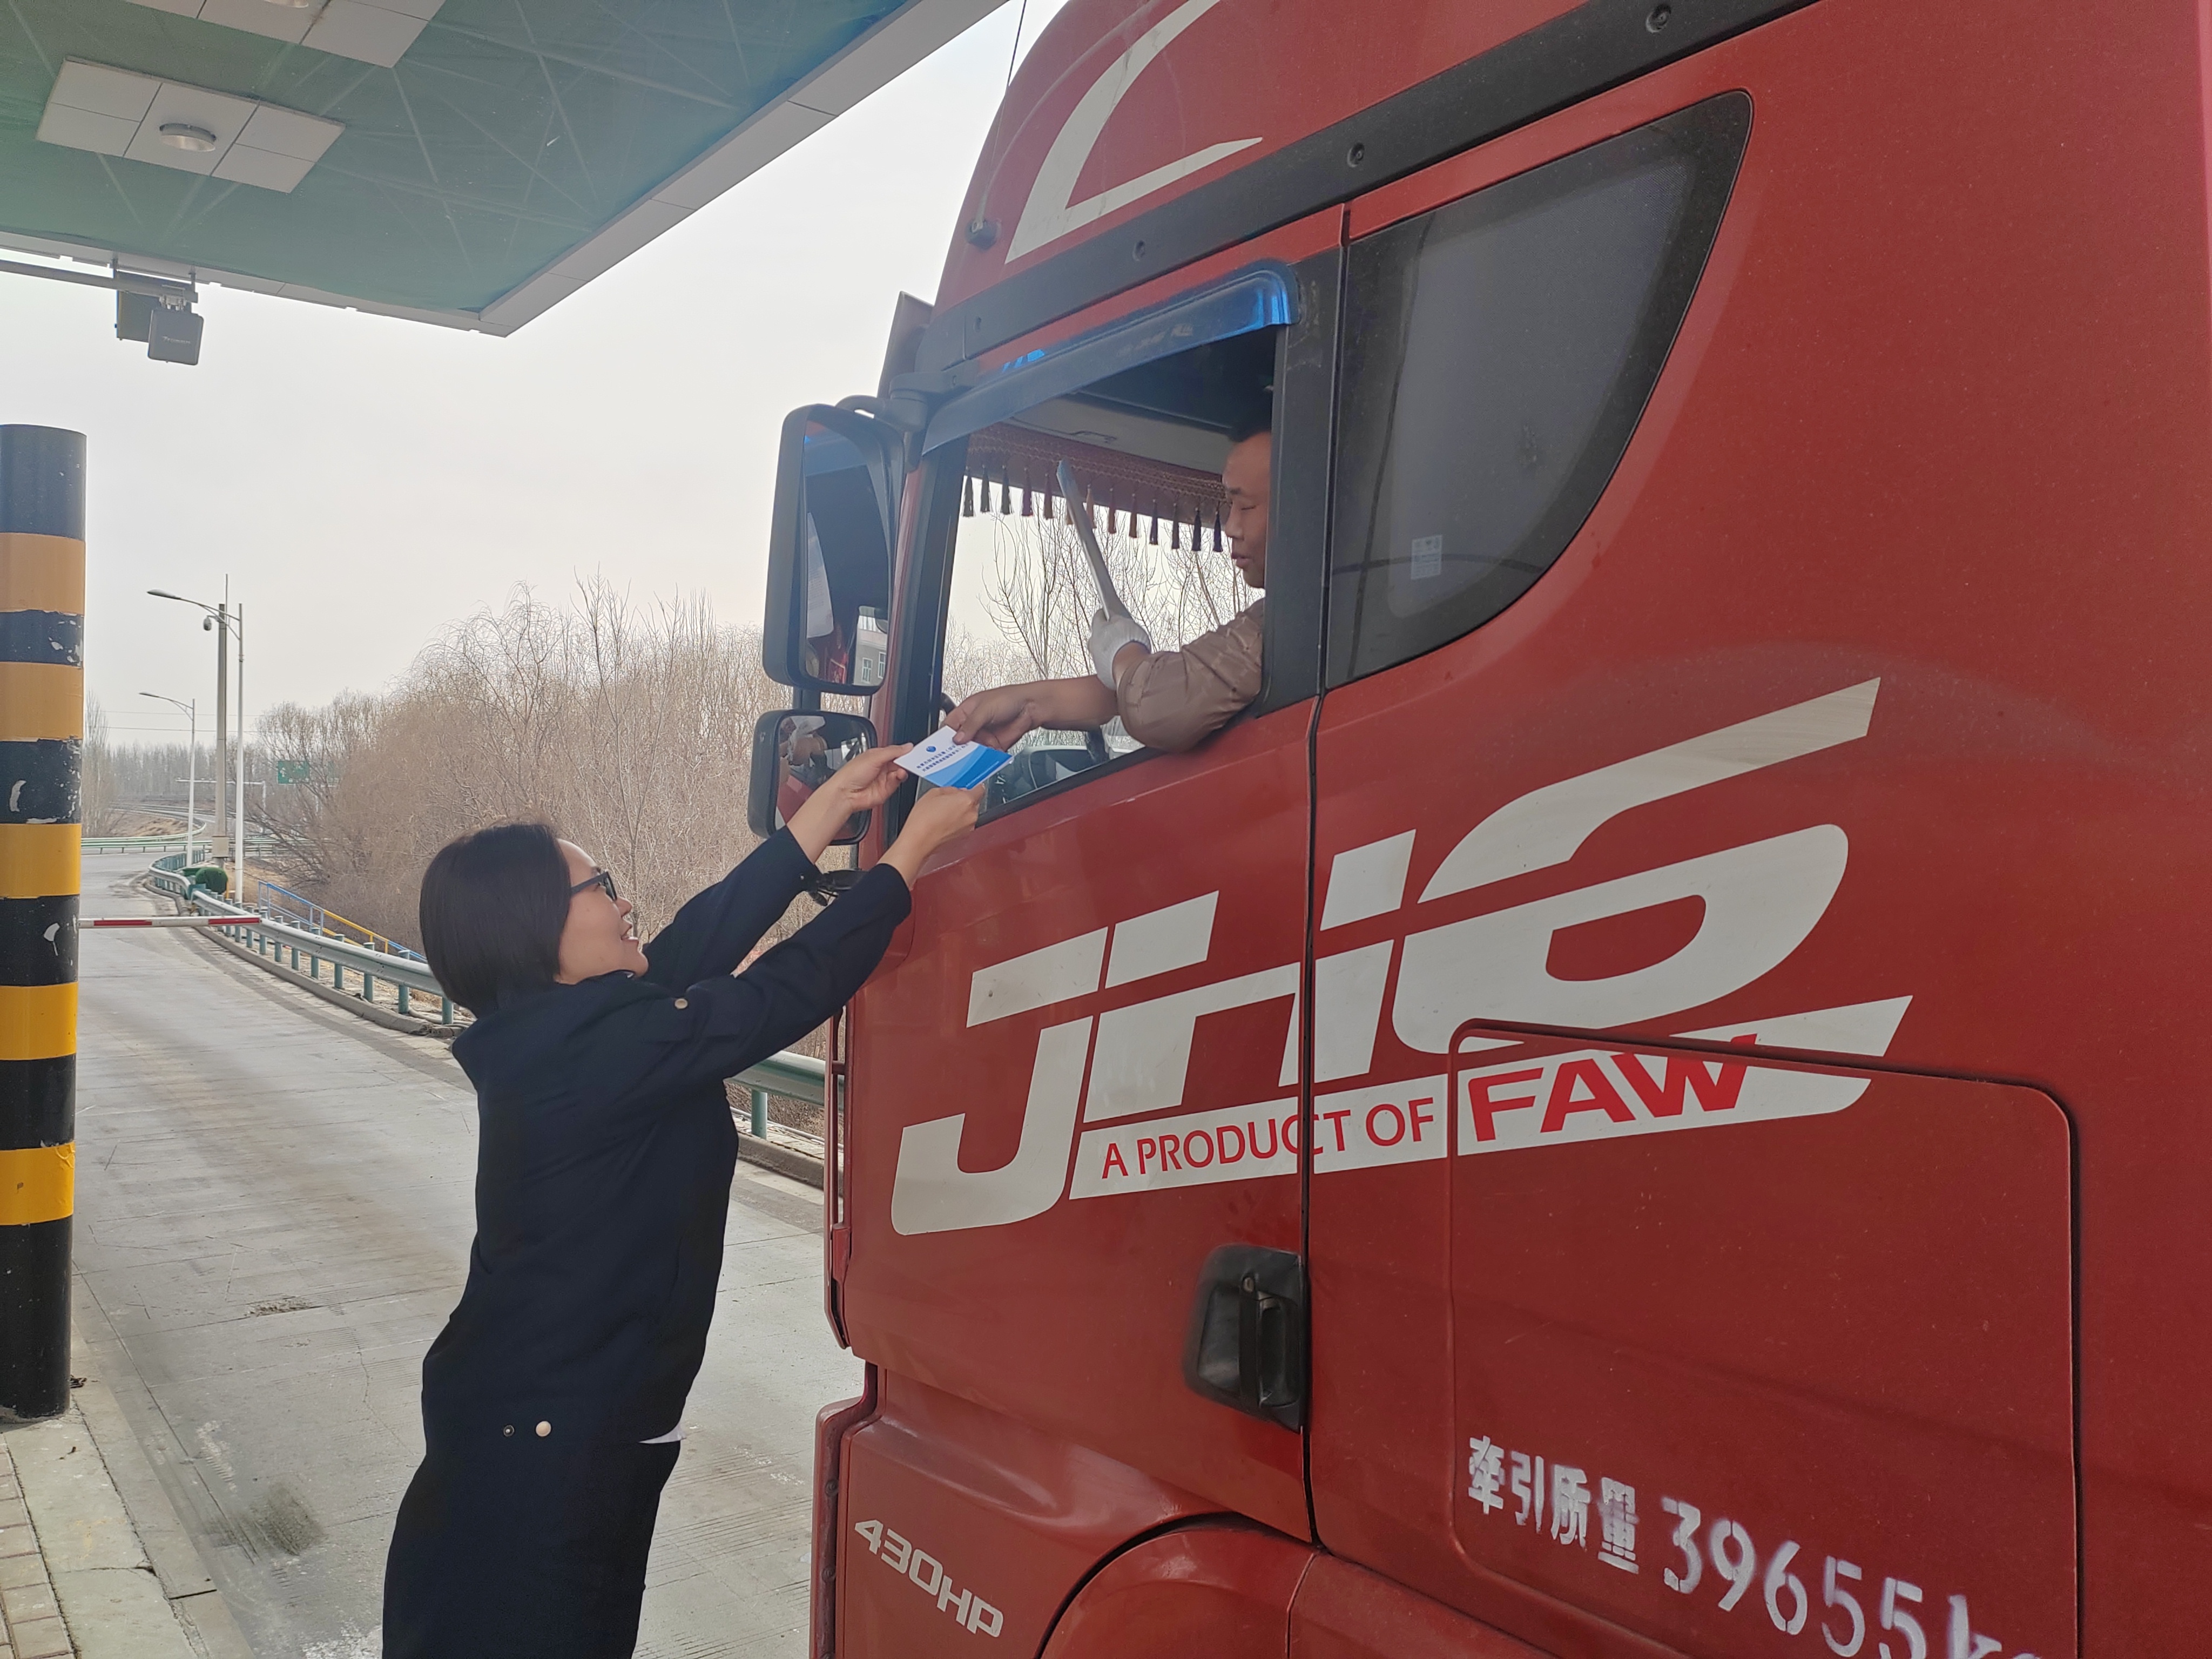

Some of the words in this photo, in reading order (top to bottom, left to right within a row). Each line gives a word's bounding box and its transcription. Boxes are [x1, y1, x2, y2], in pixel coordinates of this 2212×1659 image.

[1102, 1143, 1129, 1179] A
[1137, 1109, 1352, 1175] PRODUCT
[1365, 1097, 1434, 1147] OF
[1468, 1034, 1758, 1142] FAW
[855, 1520, 1003, 1637] 430HP
[1468, 1435, 1639, 1574] 牵引质量
[1662, 1496, 2042, 1659] 39655k
